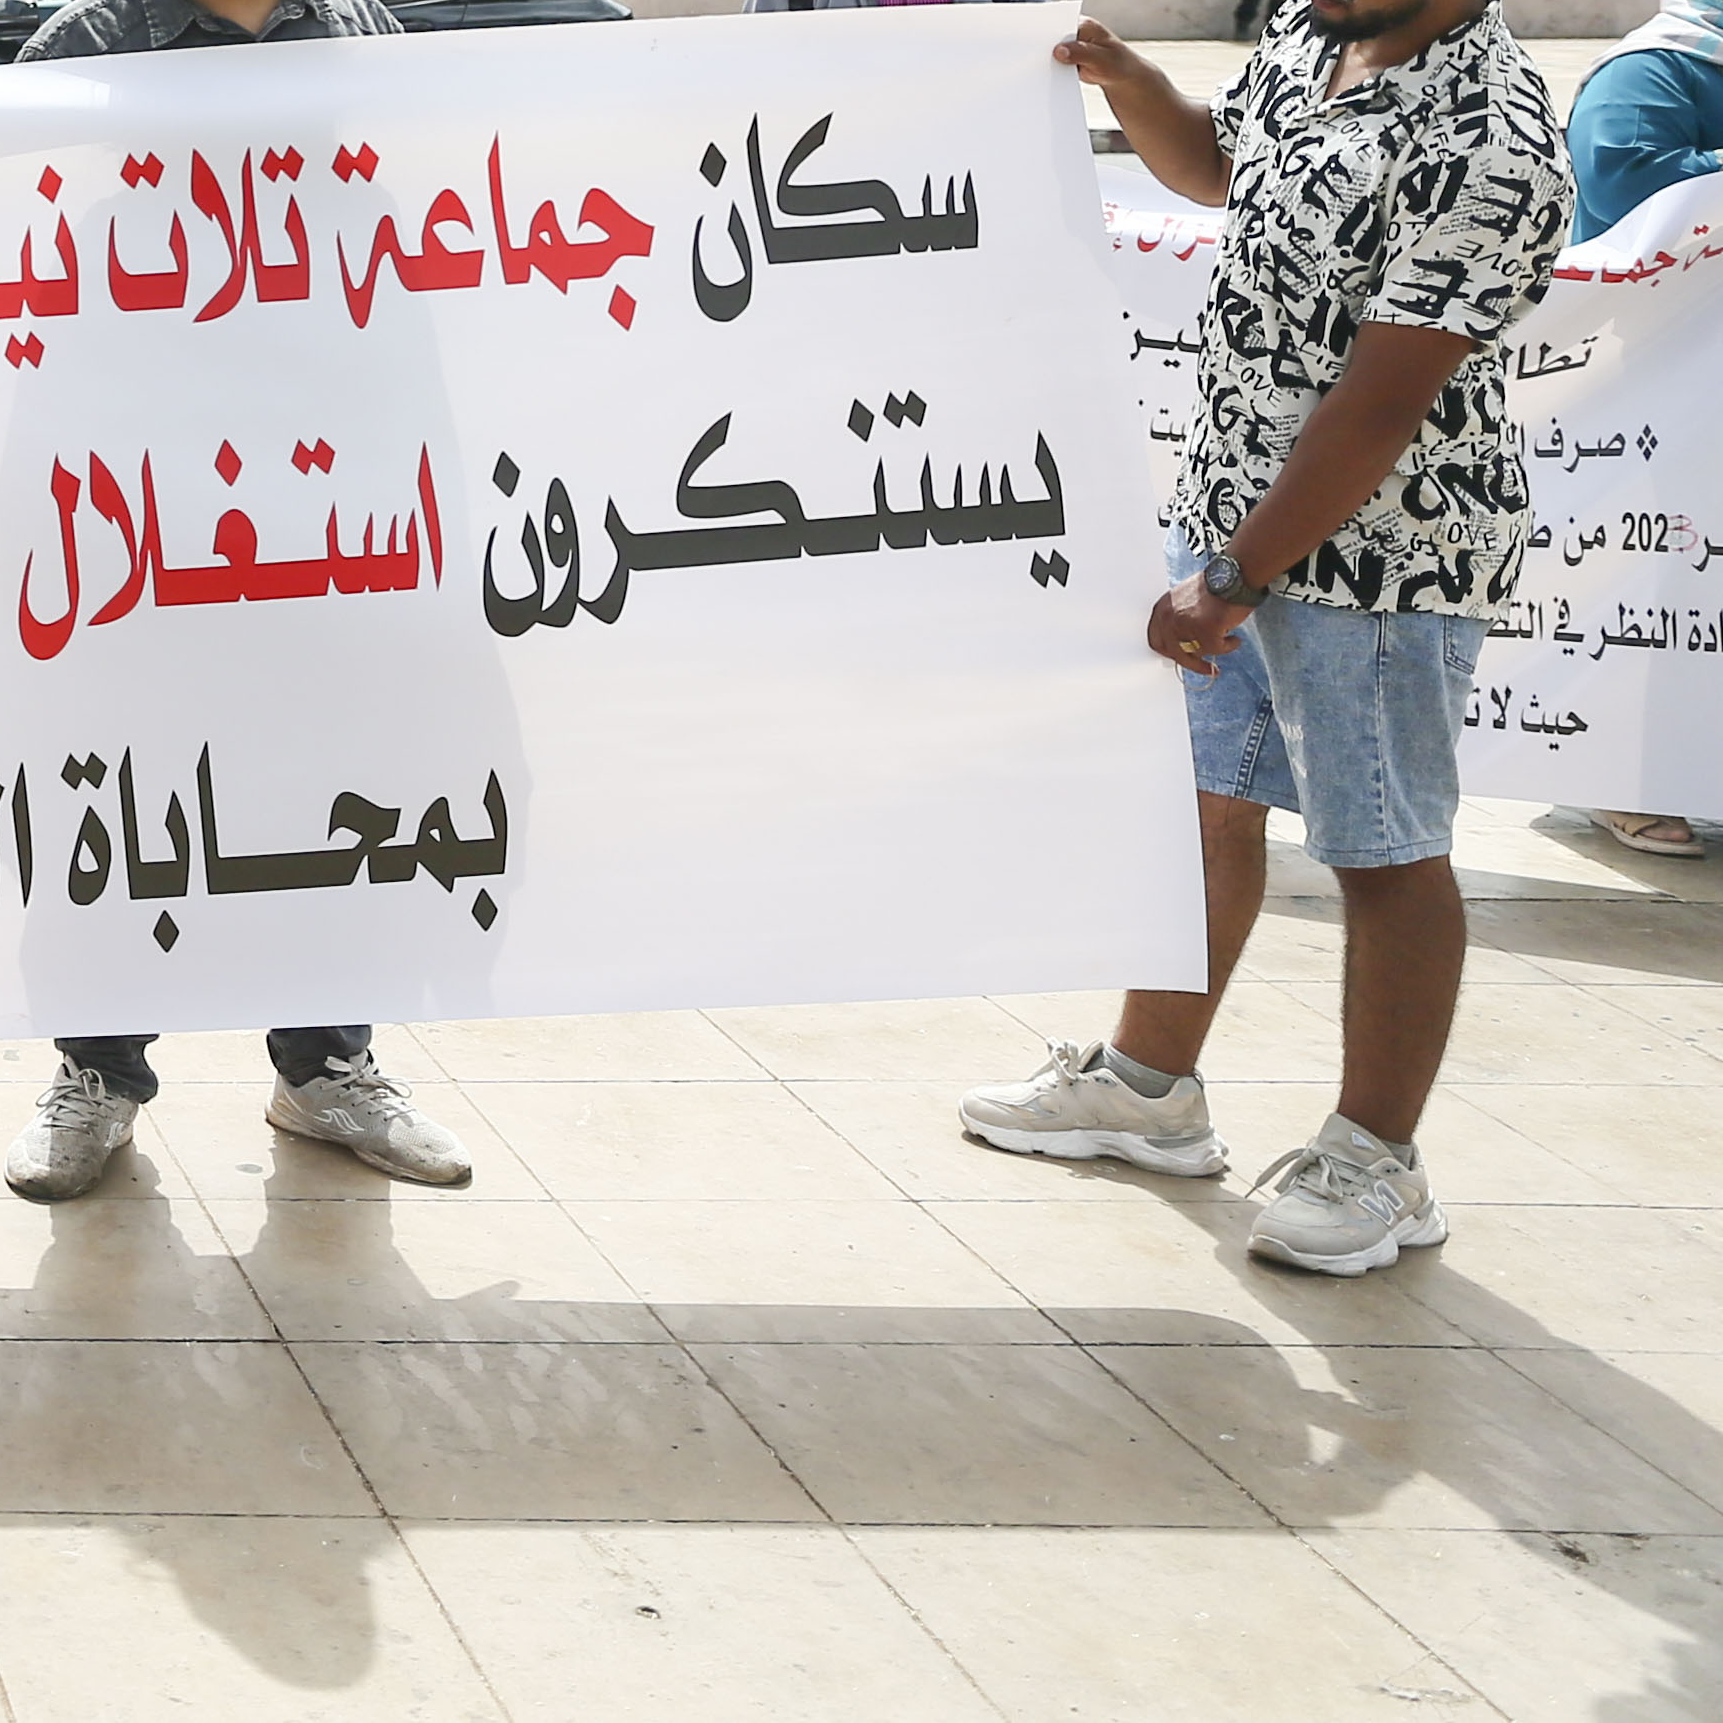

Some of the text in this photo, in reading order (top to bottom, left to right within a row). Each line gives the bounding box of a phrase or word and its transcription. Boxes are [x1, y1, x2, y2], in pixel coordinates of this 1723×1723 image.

[108, 145, 310, 323] تلات
[331, 131, 655, 330] جماعة
[692, 112, 979, 323] سكان
[1533, 417, 1627, 473] صرف
[18, 437, 443, 661] استغلال
[482, 389, 1070, 638] يستنكرون
[1563, 516, 1607, 566] من
[1553, 596, 1585, 656] في
[1588, 602, 1678, 661] النظر
[1490, 684, 1513, 730] لا
[1521, 693, 1589, 751] حيث
[60, 740, 508, 953] بمحاباة
